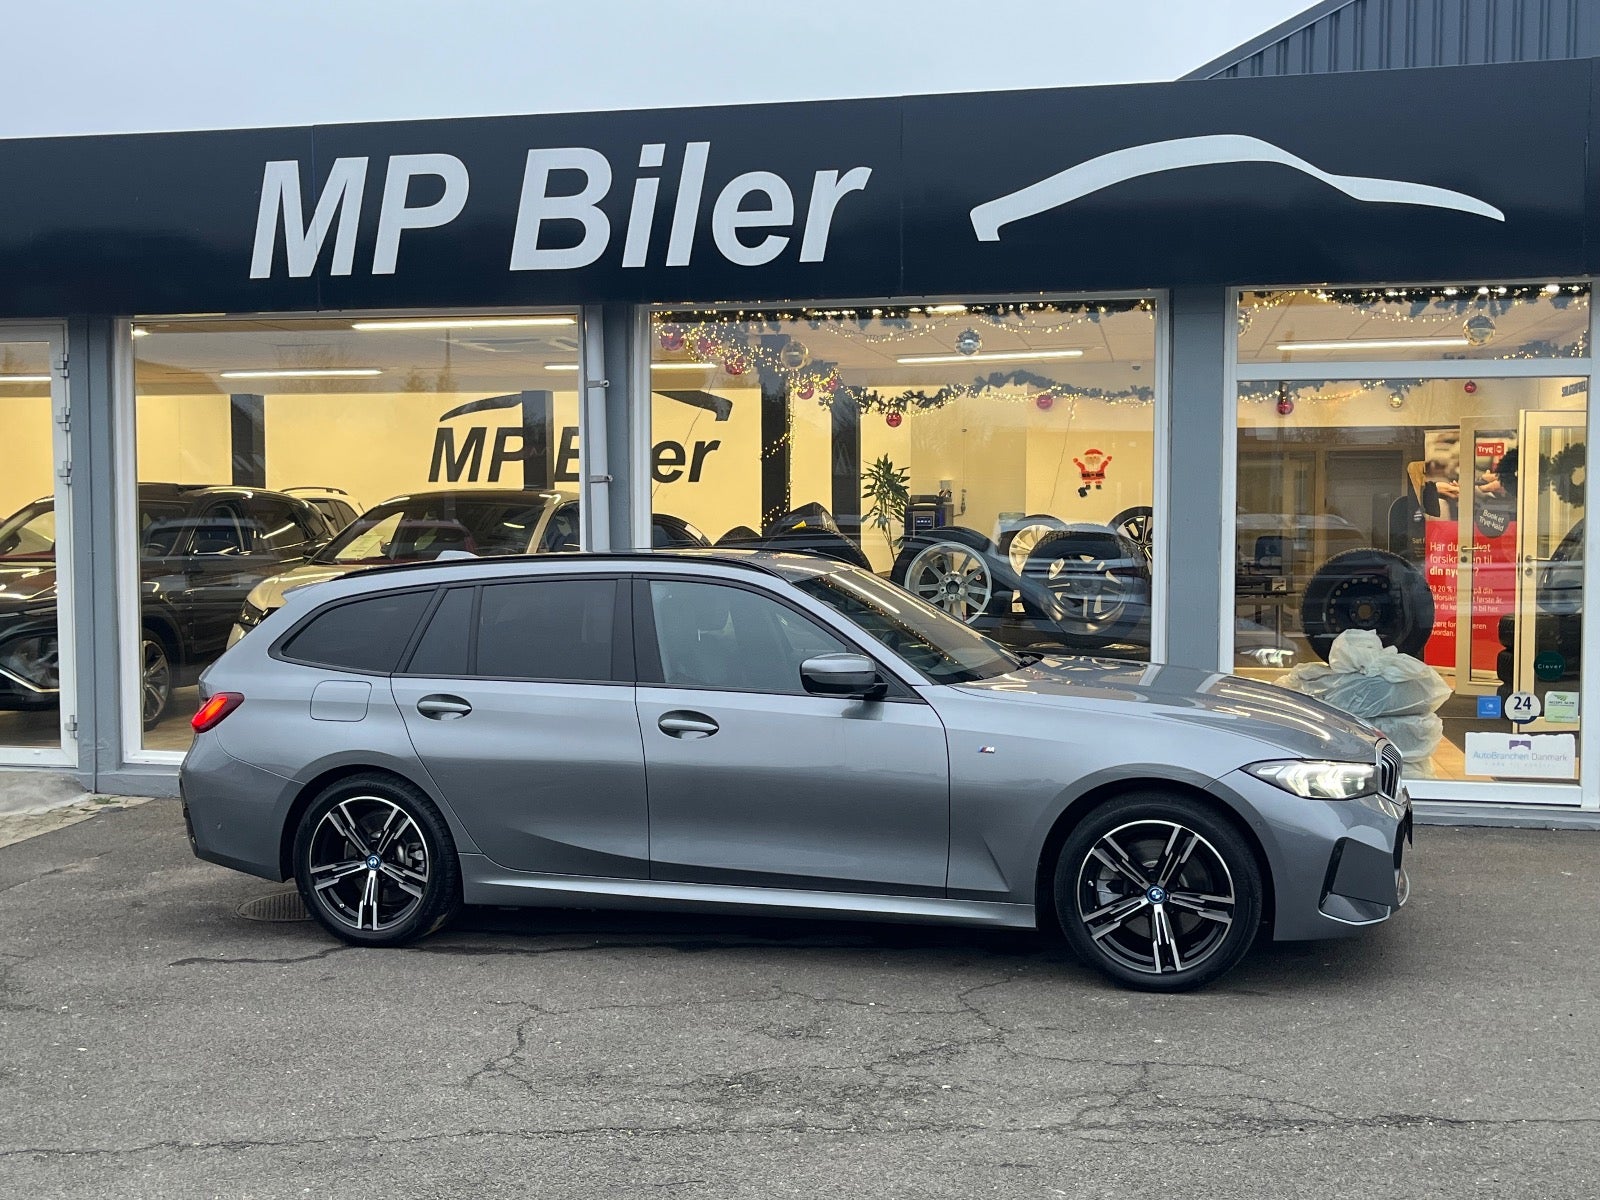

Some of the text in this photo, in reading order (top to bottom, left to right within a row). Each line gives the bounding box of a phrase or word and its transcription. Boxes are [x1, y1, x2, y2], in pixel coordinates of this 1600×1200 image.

[249, 141, 873, 279] MP Biler
[428, 427, 525, 483] MP
[1478, 446, 1494, 454] Tryg
[1483, 509, 1498, 521] Book
[1430, 542, 1445, 552] Har
[1447, 543, 1458, 552] du
[1483, 555, 1492, 565] til
[1430, 566, 1443, 575] din
[1514, 696, 1532, 710] 24
[1473, 751, 1568, 761] AutoBranchen Danmark
